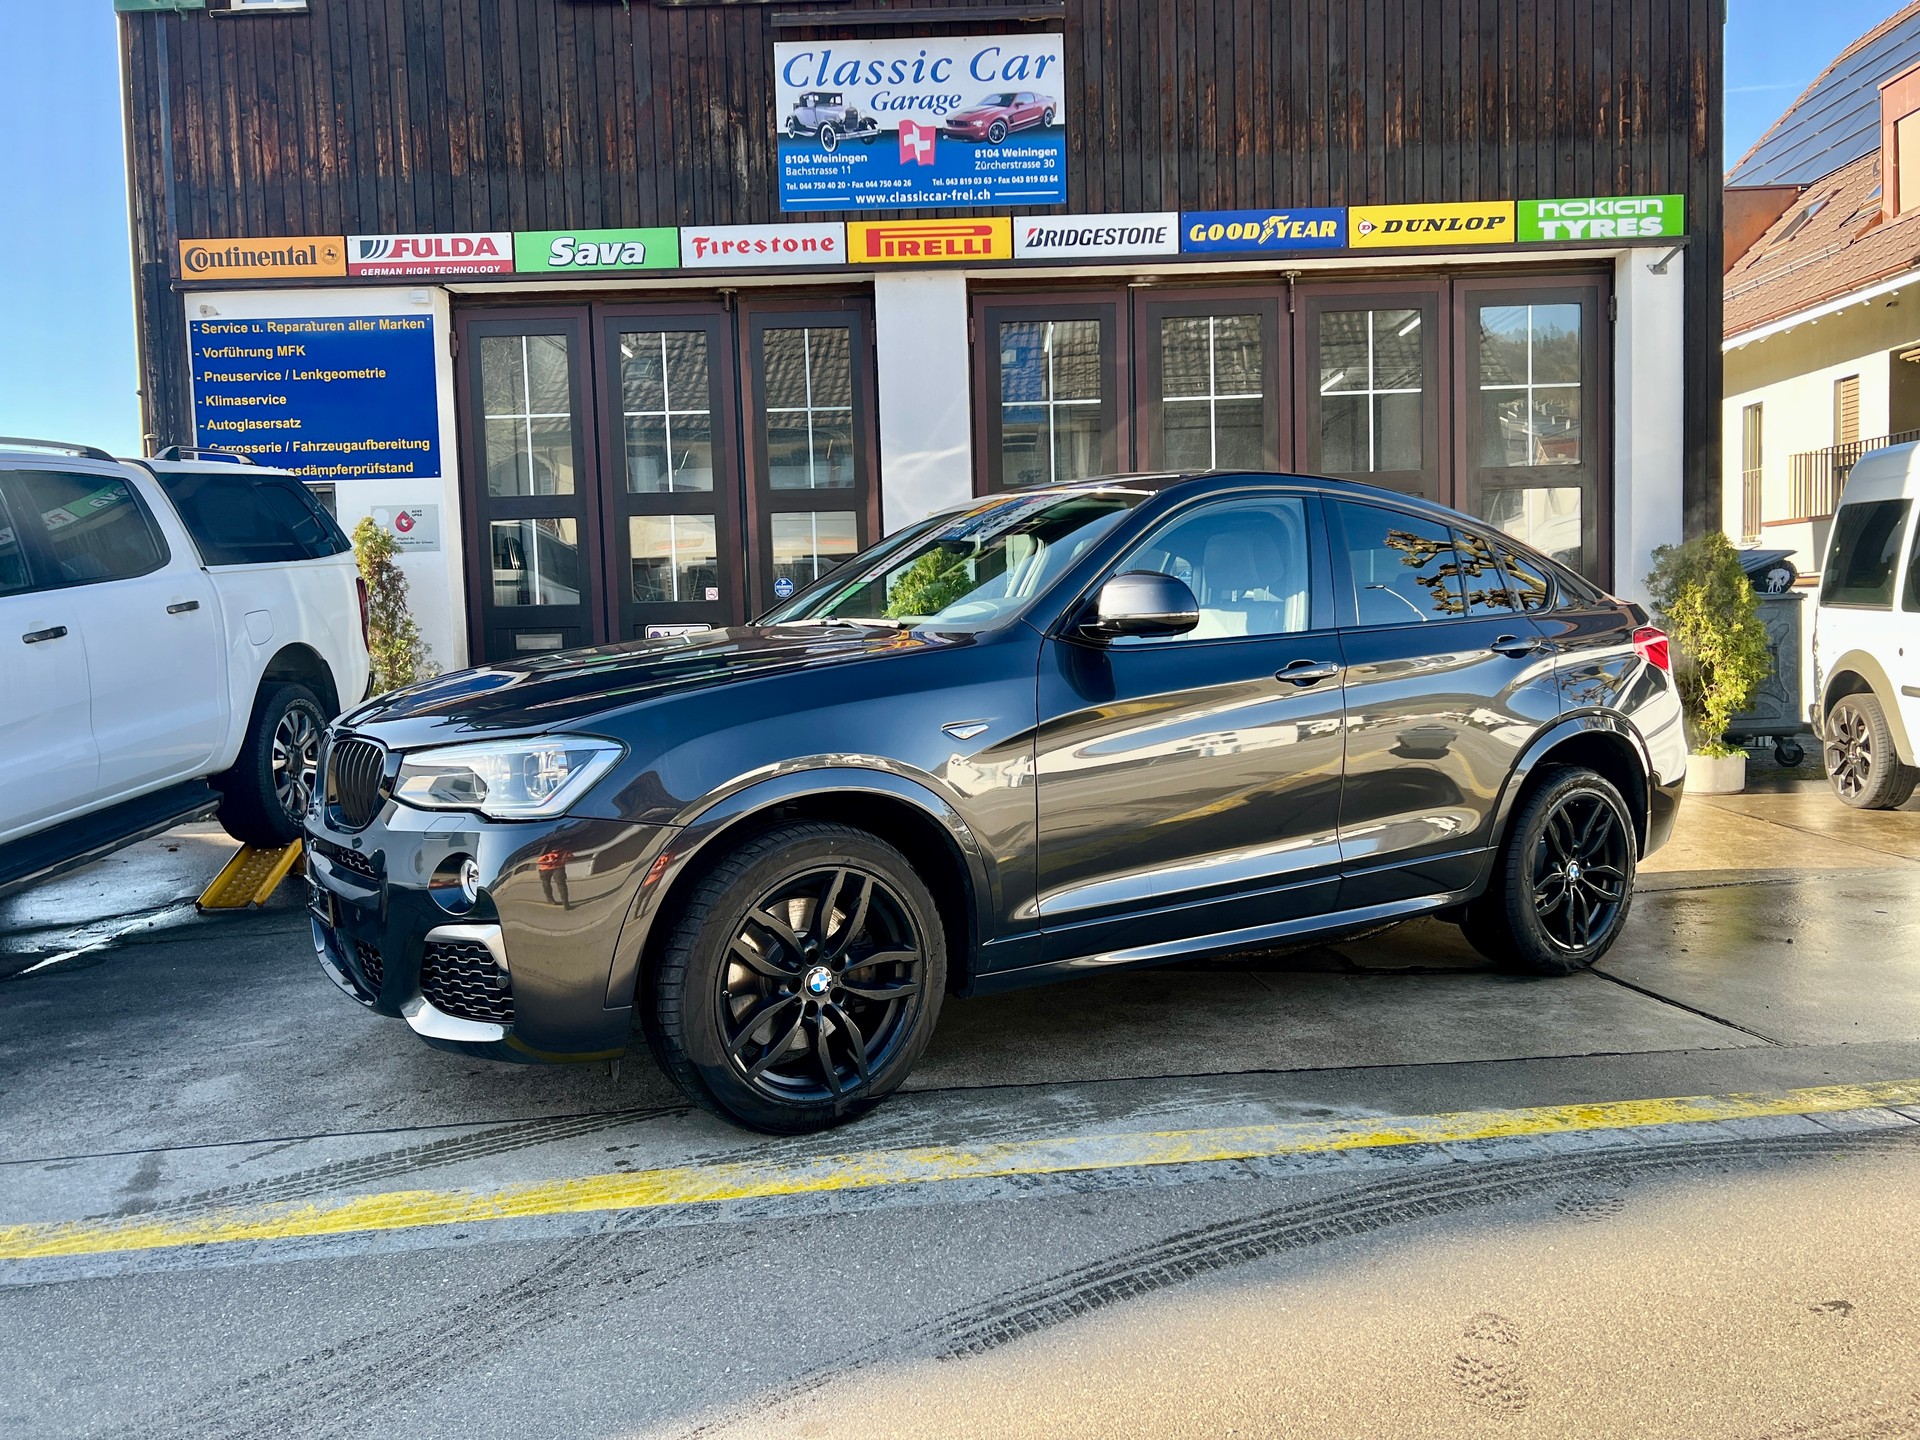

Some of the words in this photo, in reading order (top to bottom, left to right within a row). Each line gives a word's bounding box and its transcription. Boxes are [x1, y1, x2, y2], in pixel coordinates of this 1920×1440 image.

[783, 50, 953, 87] Classic
[970, 47, 1056, 81] Car
[870, 90, 962, 116] Garage
[785, 154, 810, 164] 8104
[812, 153, 868, 165] Weiningen
[974, 148, 1000, 158] 8104
[1002, 147, 1057, 159] Weiningen
[785, 166, 839, 176] Bachstrasse
[841, 165, 851, 174] 11
[974, 160, 1041, 170] Zürcherstrasse
[1043, 159, 1055, 168] 30
[786, 182, 798, 190] Tel.
[799, 182, 812, 190] 044
[827, 181, 836, 189] 40
[837, 181, 846, 189] 20
[851, 181, 864, 189] Fax
[865, 180, 878, 188] 044
[903, 179, 912, 187] 26
[932, 178, 945, 186] Tel.
[946, 178, 958, 186] 043
[959, 177, 972, 185] 819
[973, 177, 982, 185] 03
[983, 176, 992, 184] 63
[998, 176, 1011, 184] Fax
[1025, 175, 1038, 183] 819
[1039, 175, 1048, 183] 03
[1049, 174, 1058, 182] 64
[855, 188, 991, 204] www.classiccar-frei.ch
[1537, 199, 1663, 216] nokian
[1381, 216, 1506, 234] DUNLOP
[1537, 216, 1664, 239] TYRES
[866, 225, 993, 257] PIRELLI
[1025, 226, 1168, 248] BRIDGESTONE
[385, 237, 499, 259] FULDA
[547, 236, 646, 267] Sava
[692, 236, 835, 259] Firestone
[184, 244, 318, 273] Continental
[360, 267, 403, 276] GERMAN
[406, 266, 431, 275] HIGH
[434, 265, 501, 274] TECHNOLOGY
[201, 321, 248, 334] Service
[252, 323, 264, 333] u.
[267, 320, 345, 335] Reparaturen
[348, 319, 375, 331] aller
[379, 318, 425, 330] Marken
[202, 346, 274, 360] Vorführung
[277, 345, 306, 357] MFK
[204, 370, 282, 383] Pneuservice
[292, 367, 386, 383] Lenkgeometrie
[205, 393, 287, 407] Klimaservice
[207, 418, 302, 432] Autoglasersatz
[293, 439, 430, 454] Fahrzeugaufbereitung
[267, 462, 414, 478] ssdämpferprüfstand
